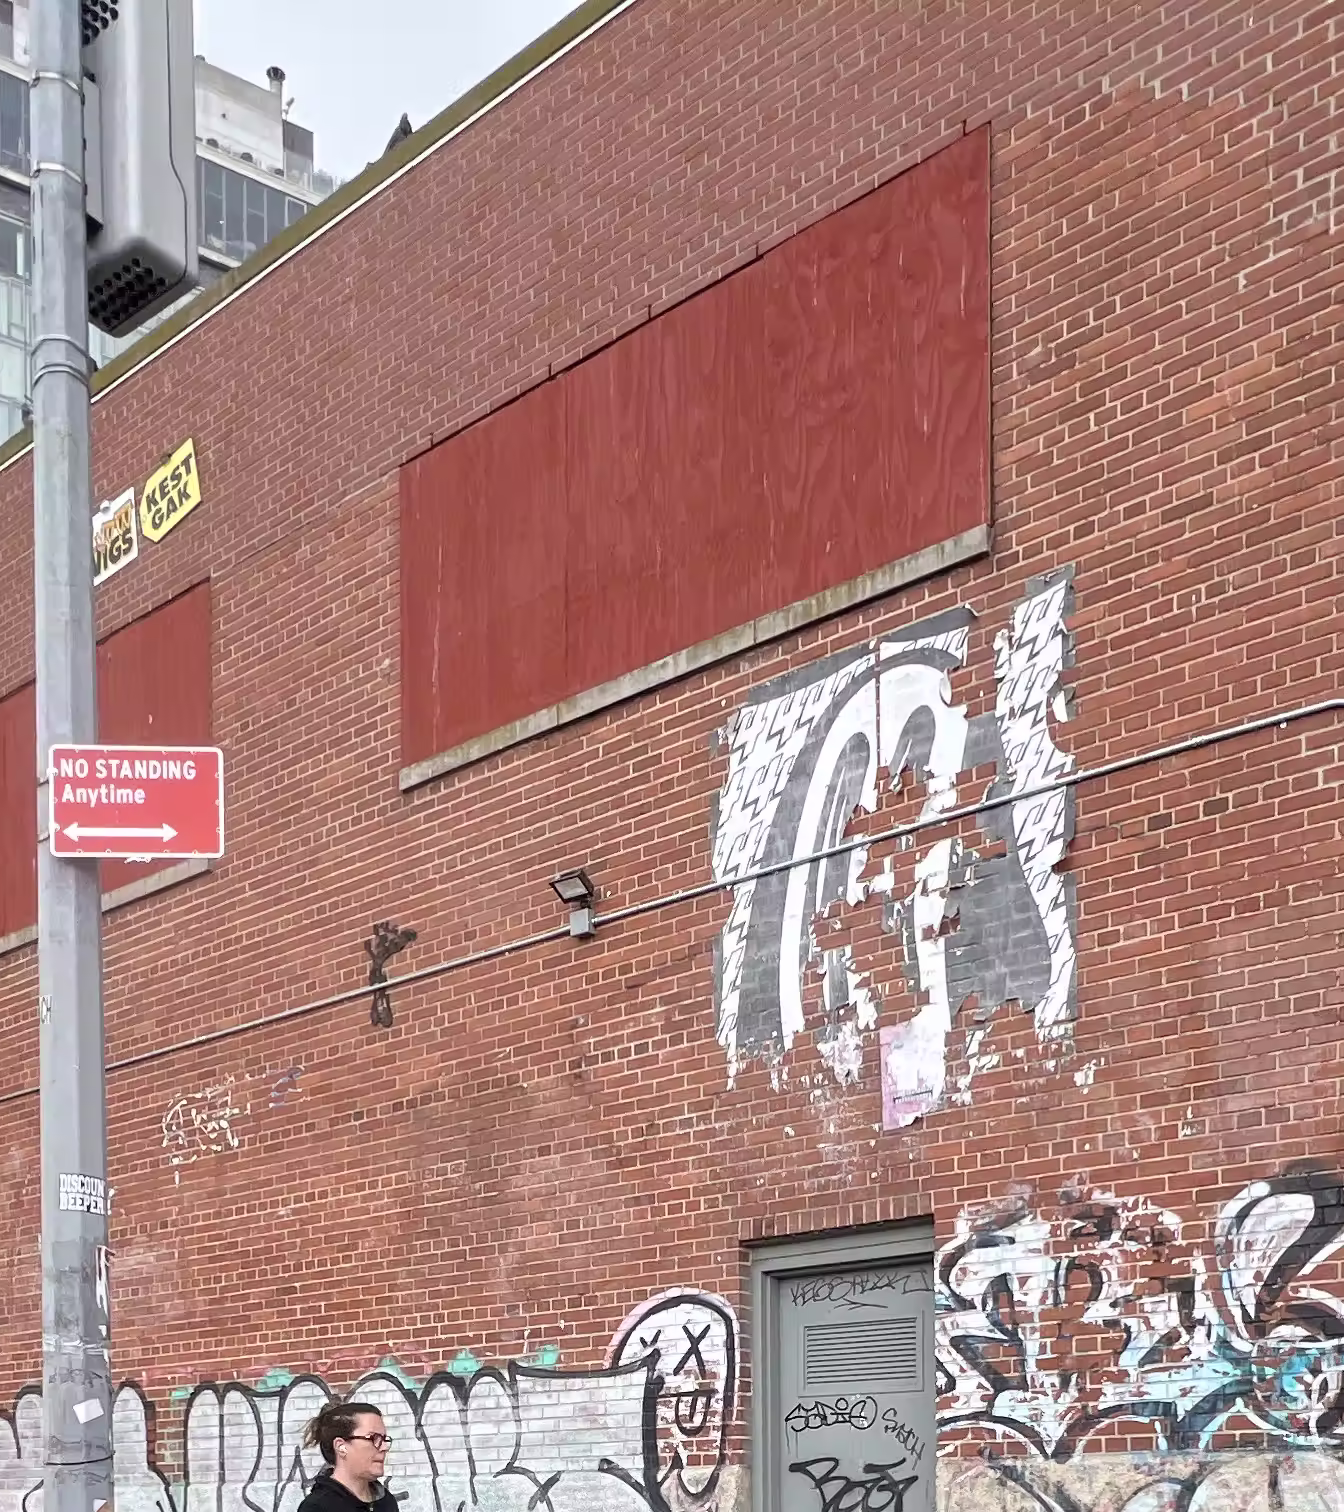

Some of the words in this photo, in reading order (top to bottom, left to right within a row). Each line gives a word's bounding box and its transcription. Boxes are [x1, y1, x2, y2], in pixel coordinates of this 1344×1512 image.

[146, 453, 193, 514] KEST
[151, 481, 192, 530] GAK
[60, 758, 89, 778] NO
[95, 759, 197, 780] STANDING
[61, 783, 146, 808] Anytime
[59, 1173, 106, 1198] DISCOUN
